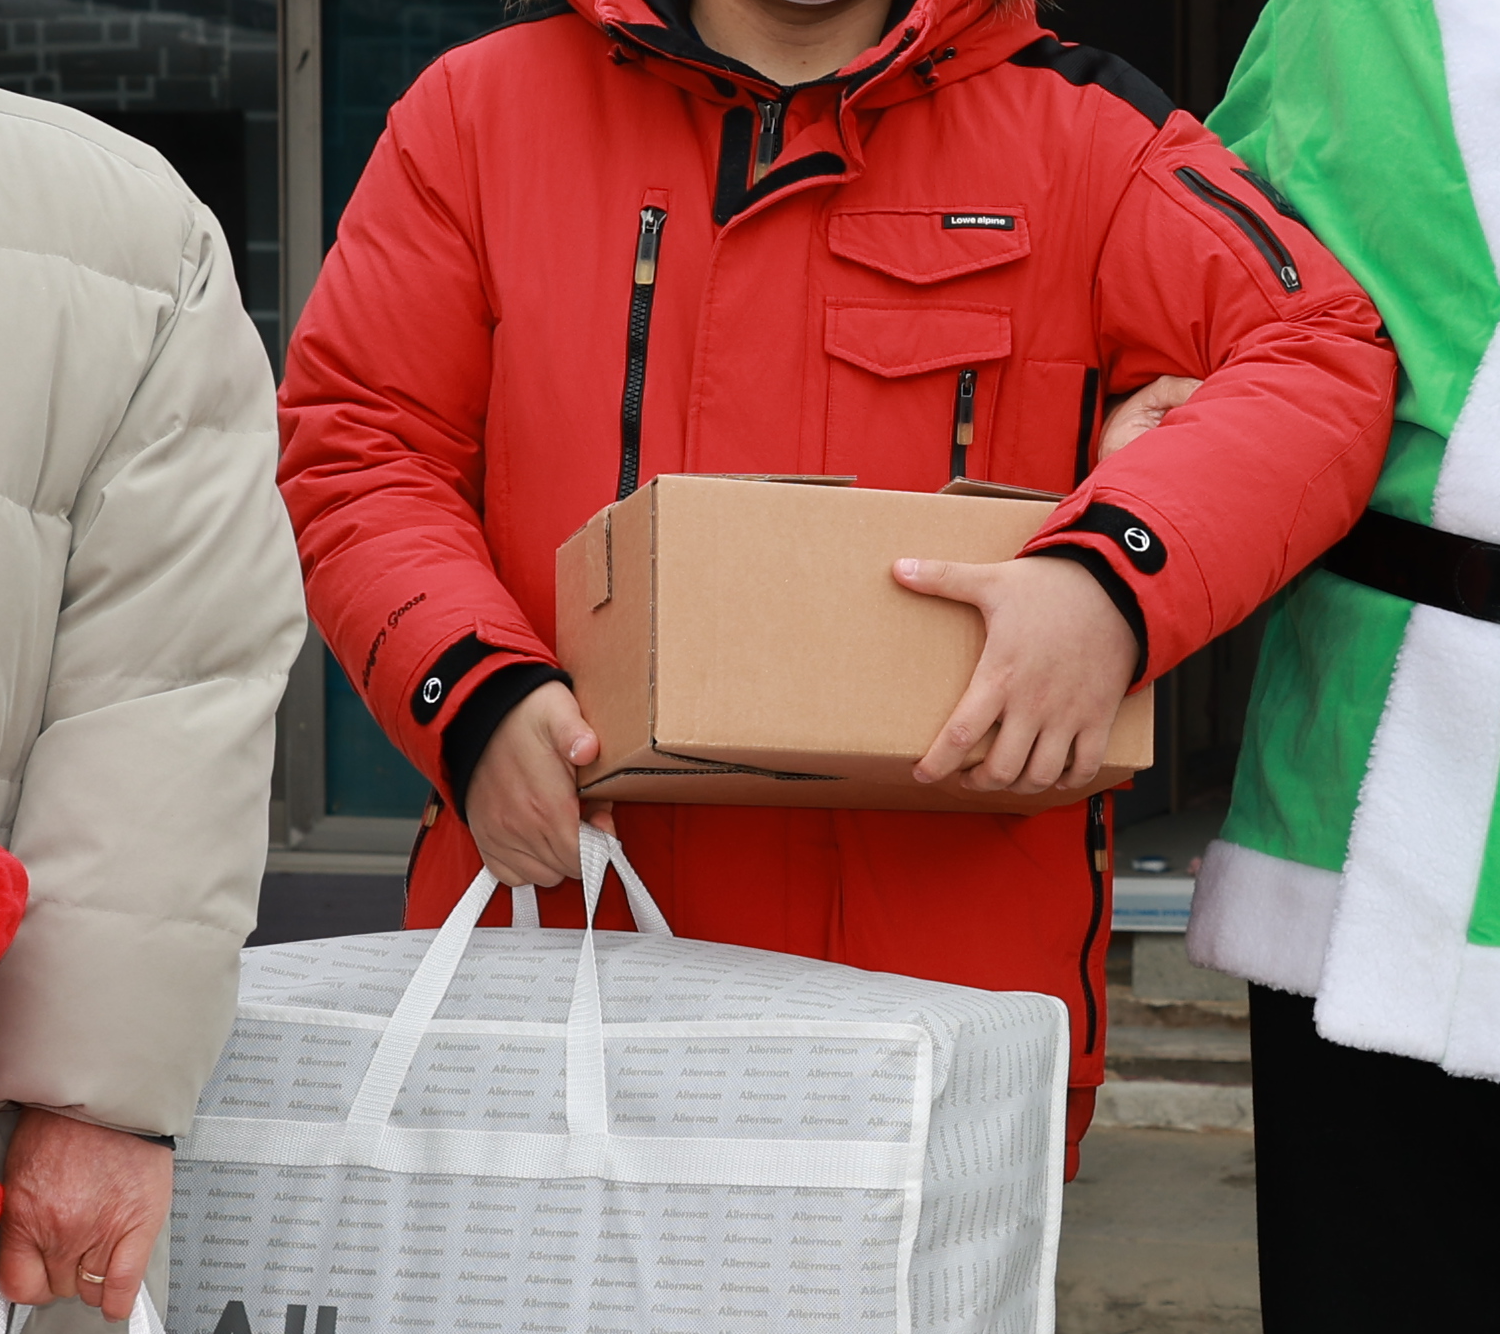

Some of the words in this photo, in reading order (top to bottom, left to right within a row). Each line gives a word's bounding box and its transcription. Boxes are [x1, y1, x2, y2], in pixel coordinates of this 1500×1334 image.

[951, 216, 976, 225] Lowe
[977, 216, 1006, 226] alpine
[300, 1032, 354, 1048] Allerman
[491, 1064, 541, 1076] Allerman
[422, 1083, 472, 1096] Allerman
[669, 1112, 720, 1127] Allerman
[206, 1187, 256, 1201] Allerman
[337, 1192, 388, 1208] Allerman
[533, 1202, 583, 1216] Allerman
[724, 1209, 776, 1221] Allerman
[464, 1224, 514, 1236] Allerman
[266, 1236, 318, 1250] Allerman
[789, 1235, 843, 1248] Allerman
[656, 1255, 706, 1268] Allerman
[327, 1263, 378, 1279] Allerman
[524, 1274, 574, 1287] Allerman
[455, 1294, 506, 1308] Allerman
[786, 1308, 841, 1321] Allerman
